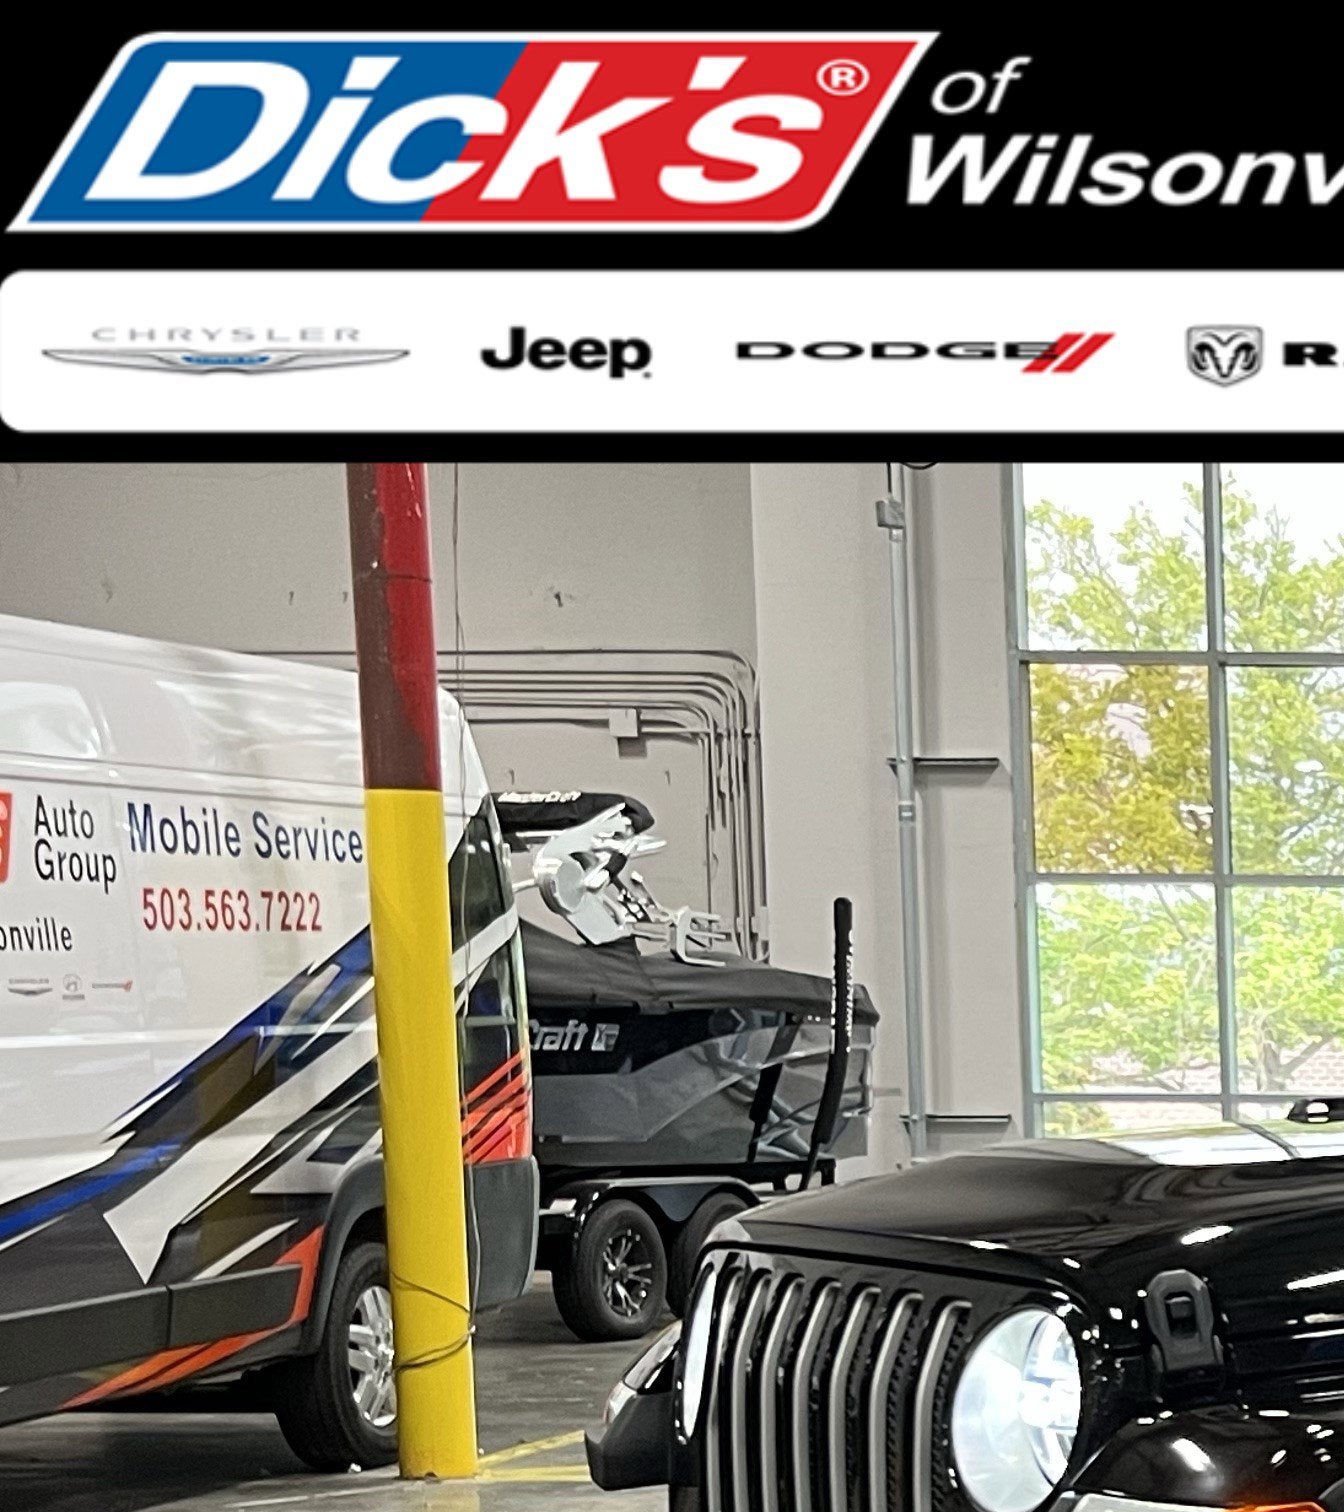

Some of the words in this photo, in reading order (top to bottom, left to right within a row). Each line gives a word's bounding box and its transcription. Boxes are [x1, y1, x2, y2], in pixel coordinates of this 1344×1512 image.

[34, 795, 95, 840] Auto
[127, 801, 241, 858] Mobile
[252, 810, 364, 864] Service
[34, 838, 117, 895] Group
[143, 886, 323, 932] 503.563.7222
